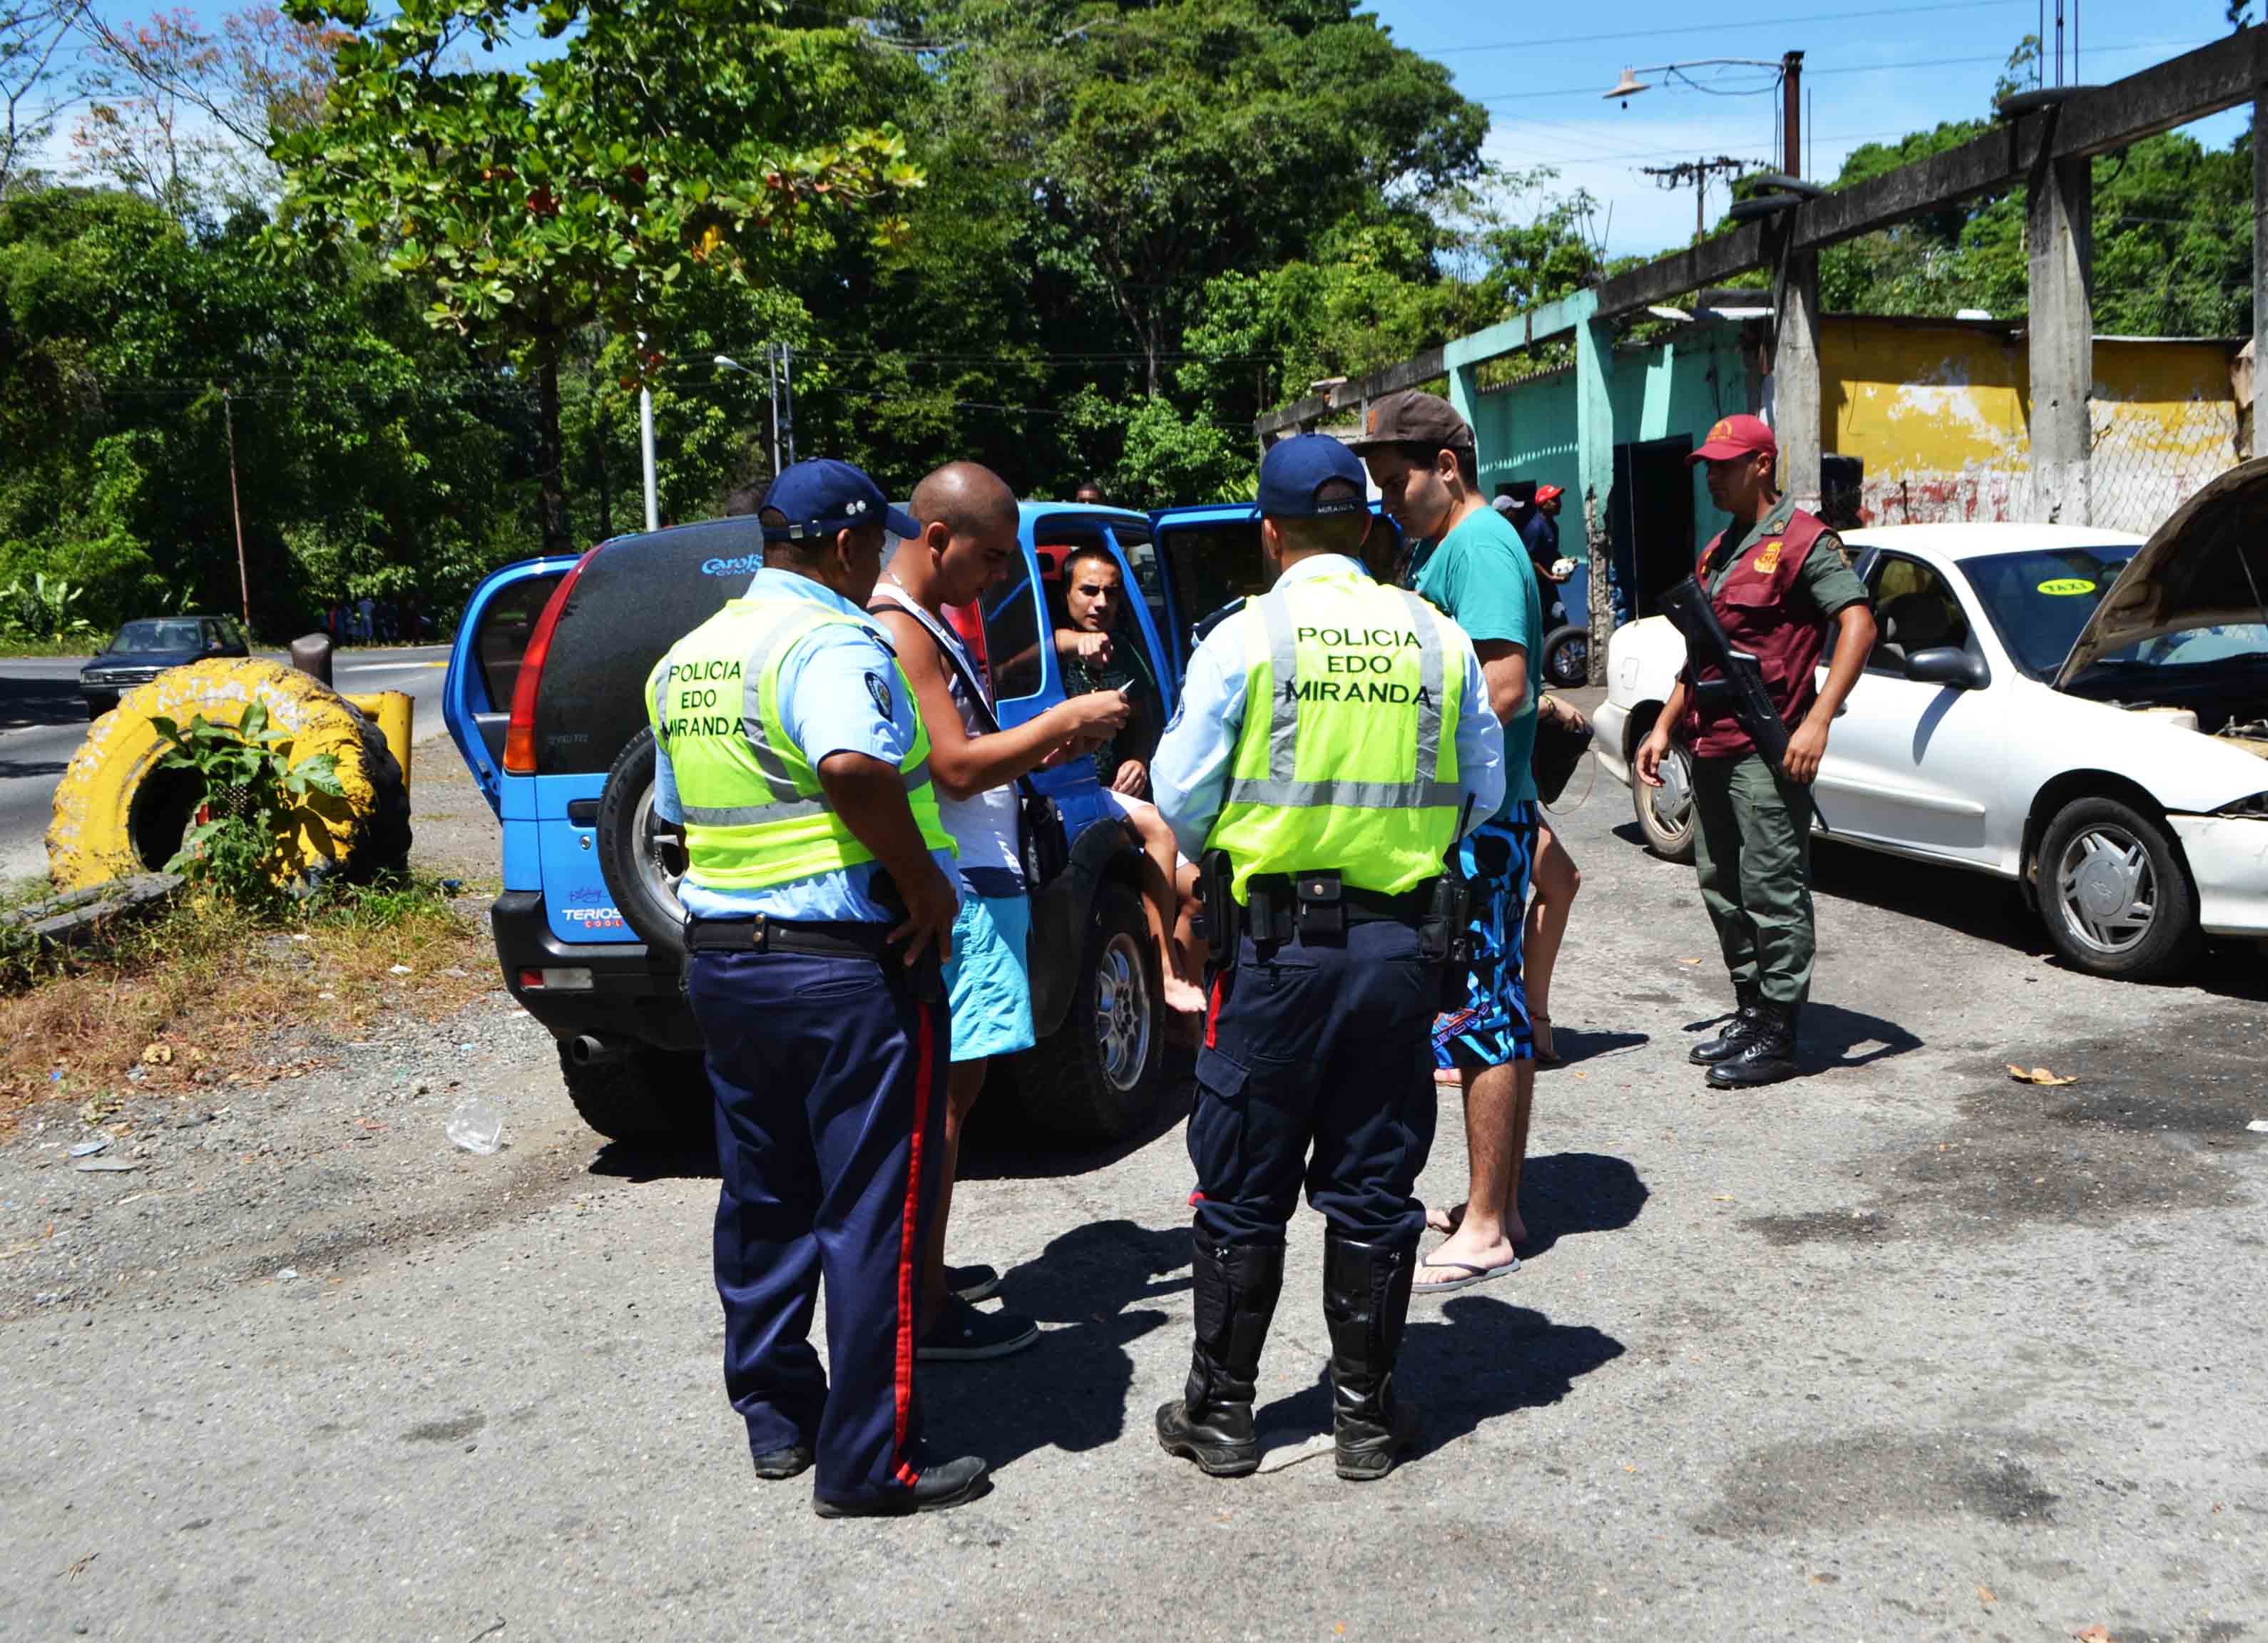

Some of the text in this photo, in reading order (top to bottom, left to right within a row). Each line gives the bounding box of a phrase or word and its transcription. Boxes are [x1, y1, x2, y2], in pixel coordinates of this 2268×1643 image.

[2043, 582, 2088, 593] TAXI
[1298, 627, 1422, 649] POLICIA
[668, 660, 741, 682] POLICIA
[1327, 655, 1391, 674] EDO
[681, 689, 716, 709] EDO
[1284, 680, 1432, 709] MIRANDA
[661, 716, 749, 737] MIRANDA
[561, 908, 623, 921] TERIOS
[586, 919, 623, 928] COOL
